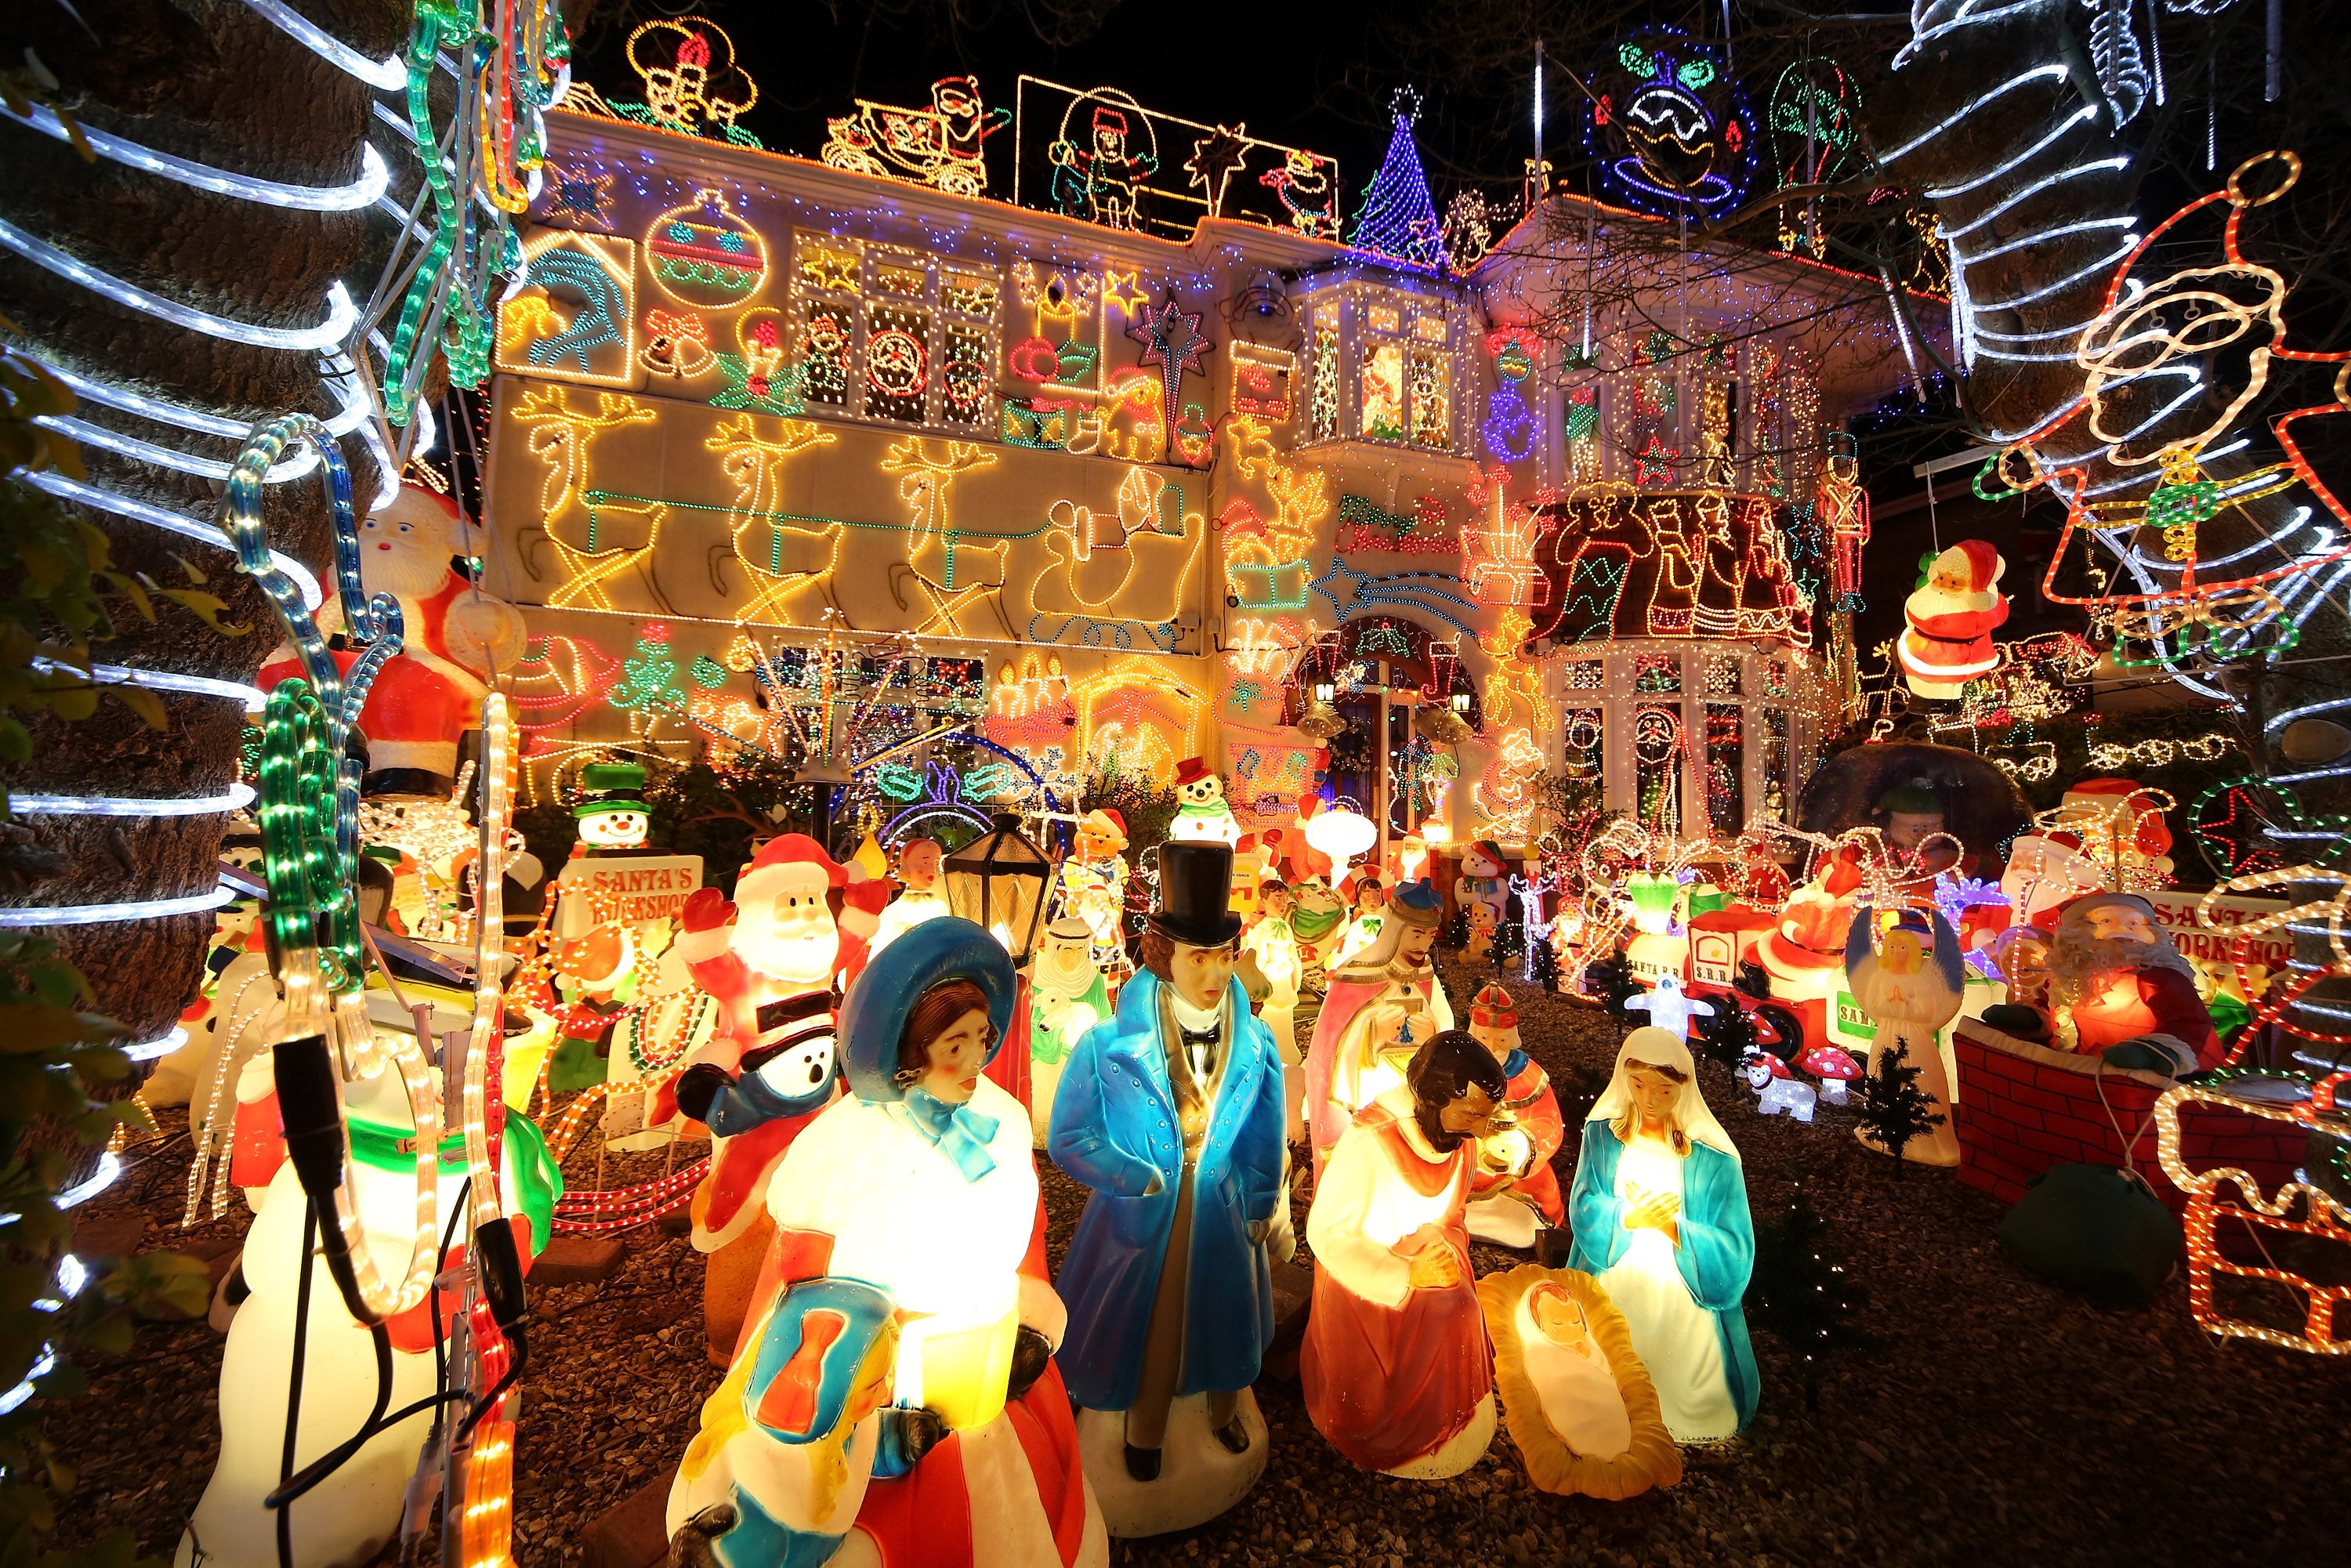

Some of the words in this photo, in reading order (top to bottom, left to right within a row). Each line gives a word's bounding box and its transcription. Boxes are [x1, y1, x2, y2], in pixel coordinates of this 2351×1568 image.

[1337, 494, 1417, 539] Merry
[593, 867, 692, 892] SANTA'S
[2154, 903, 2295, 937] SANT
[2168, 931, 2296, 964] ORKHO
[1628, 960, 1657, 976] ANTA
[1696, 966, 1733, 983] S.R.R.
[1840, 1005, 1878, 1027] SAN
